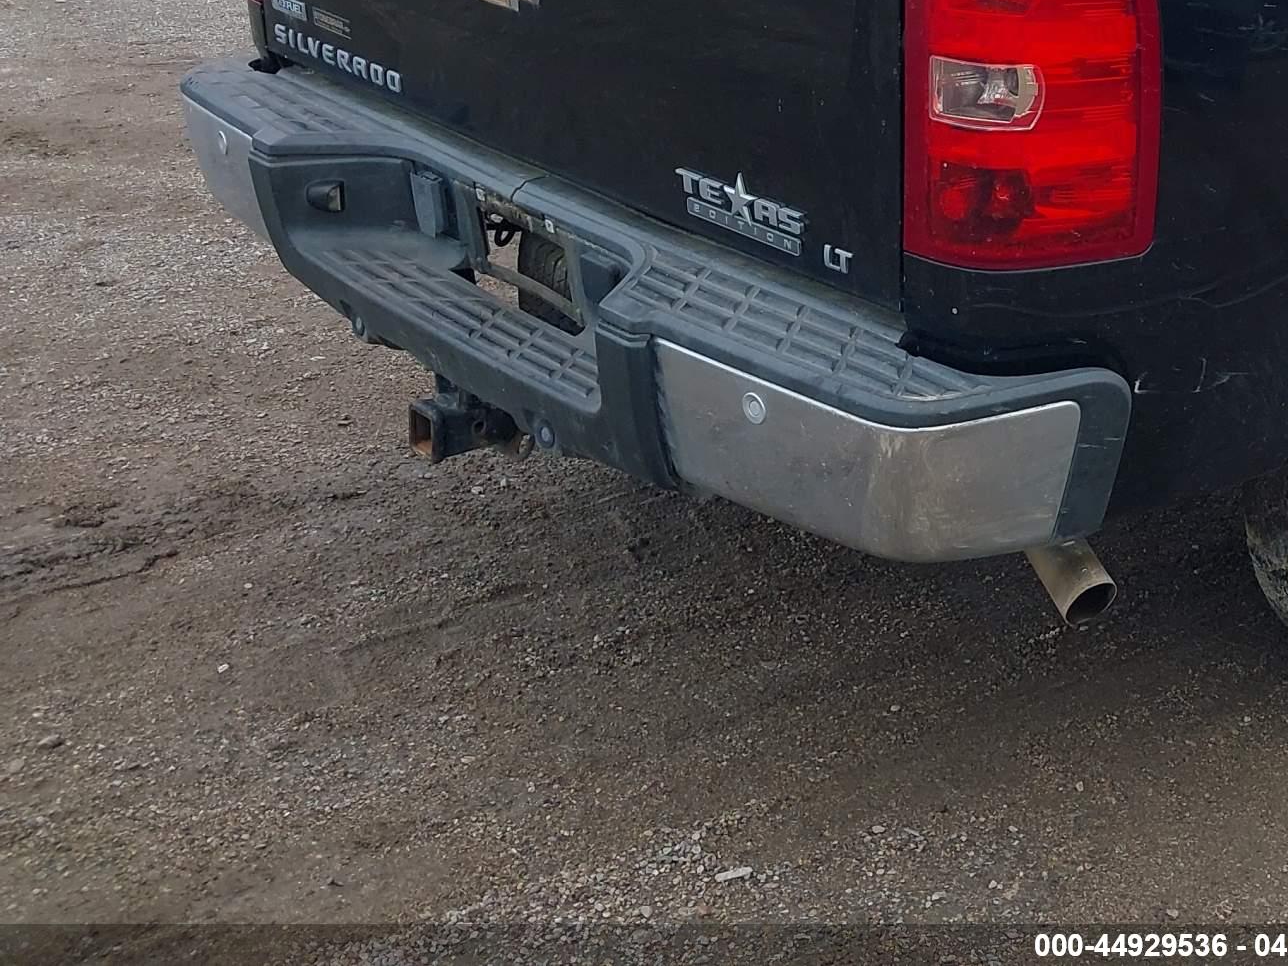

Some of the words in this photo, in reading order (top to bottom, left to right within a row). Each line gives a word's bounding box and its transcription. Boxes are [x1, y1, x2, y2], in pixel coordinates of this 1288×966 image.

[274, 23, 402, 93] SILVERADO
[674, 167, 805, 235] TEXAS
[693, 203, 793, 251] EDITION
[823, 244, 854, 274] LT
